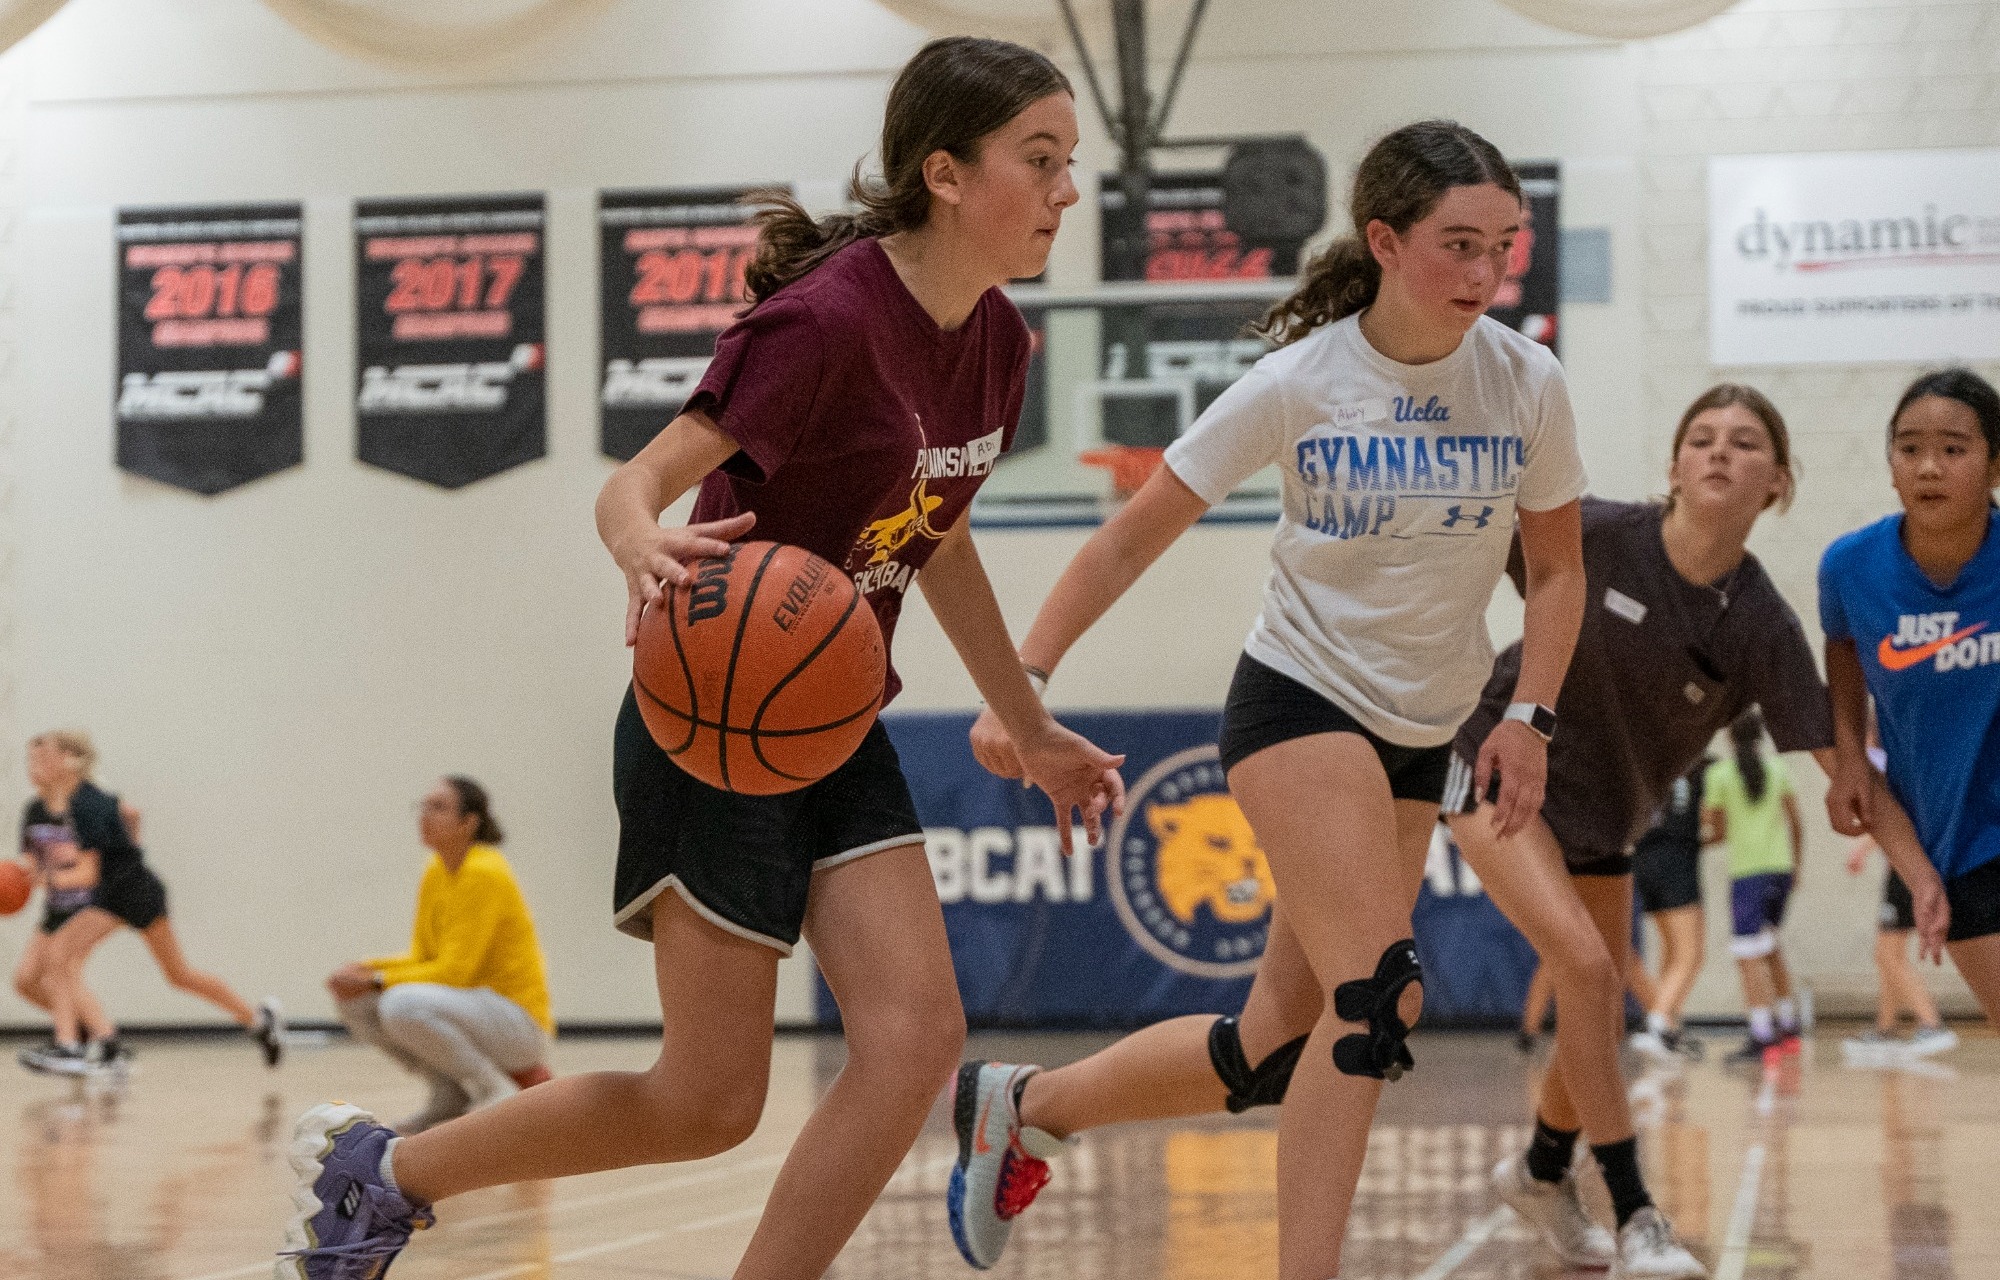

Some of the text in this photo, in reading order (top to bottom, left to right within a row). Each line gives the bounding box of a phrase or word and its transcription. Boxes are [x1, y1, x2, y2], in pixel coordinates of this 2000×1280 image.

[1736, 203, 1969, 273] dynamic
[146, 264, 279, 317] 2016
[386, 257, 524, 312] 2017
[1892, 611, 1960, 646] JUST
